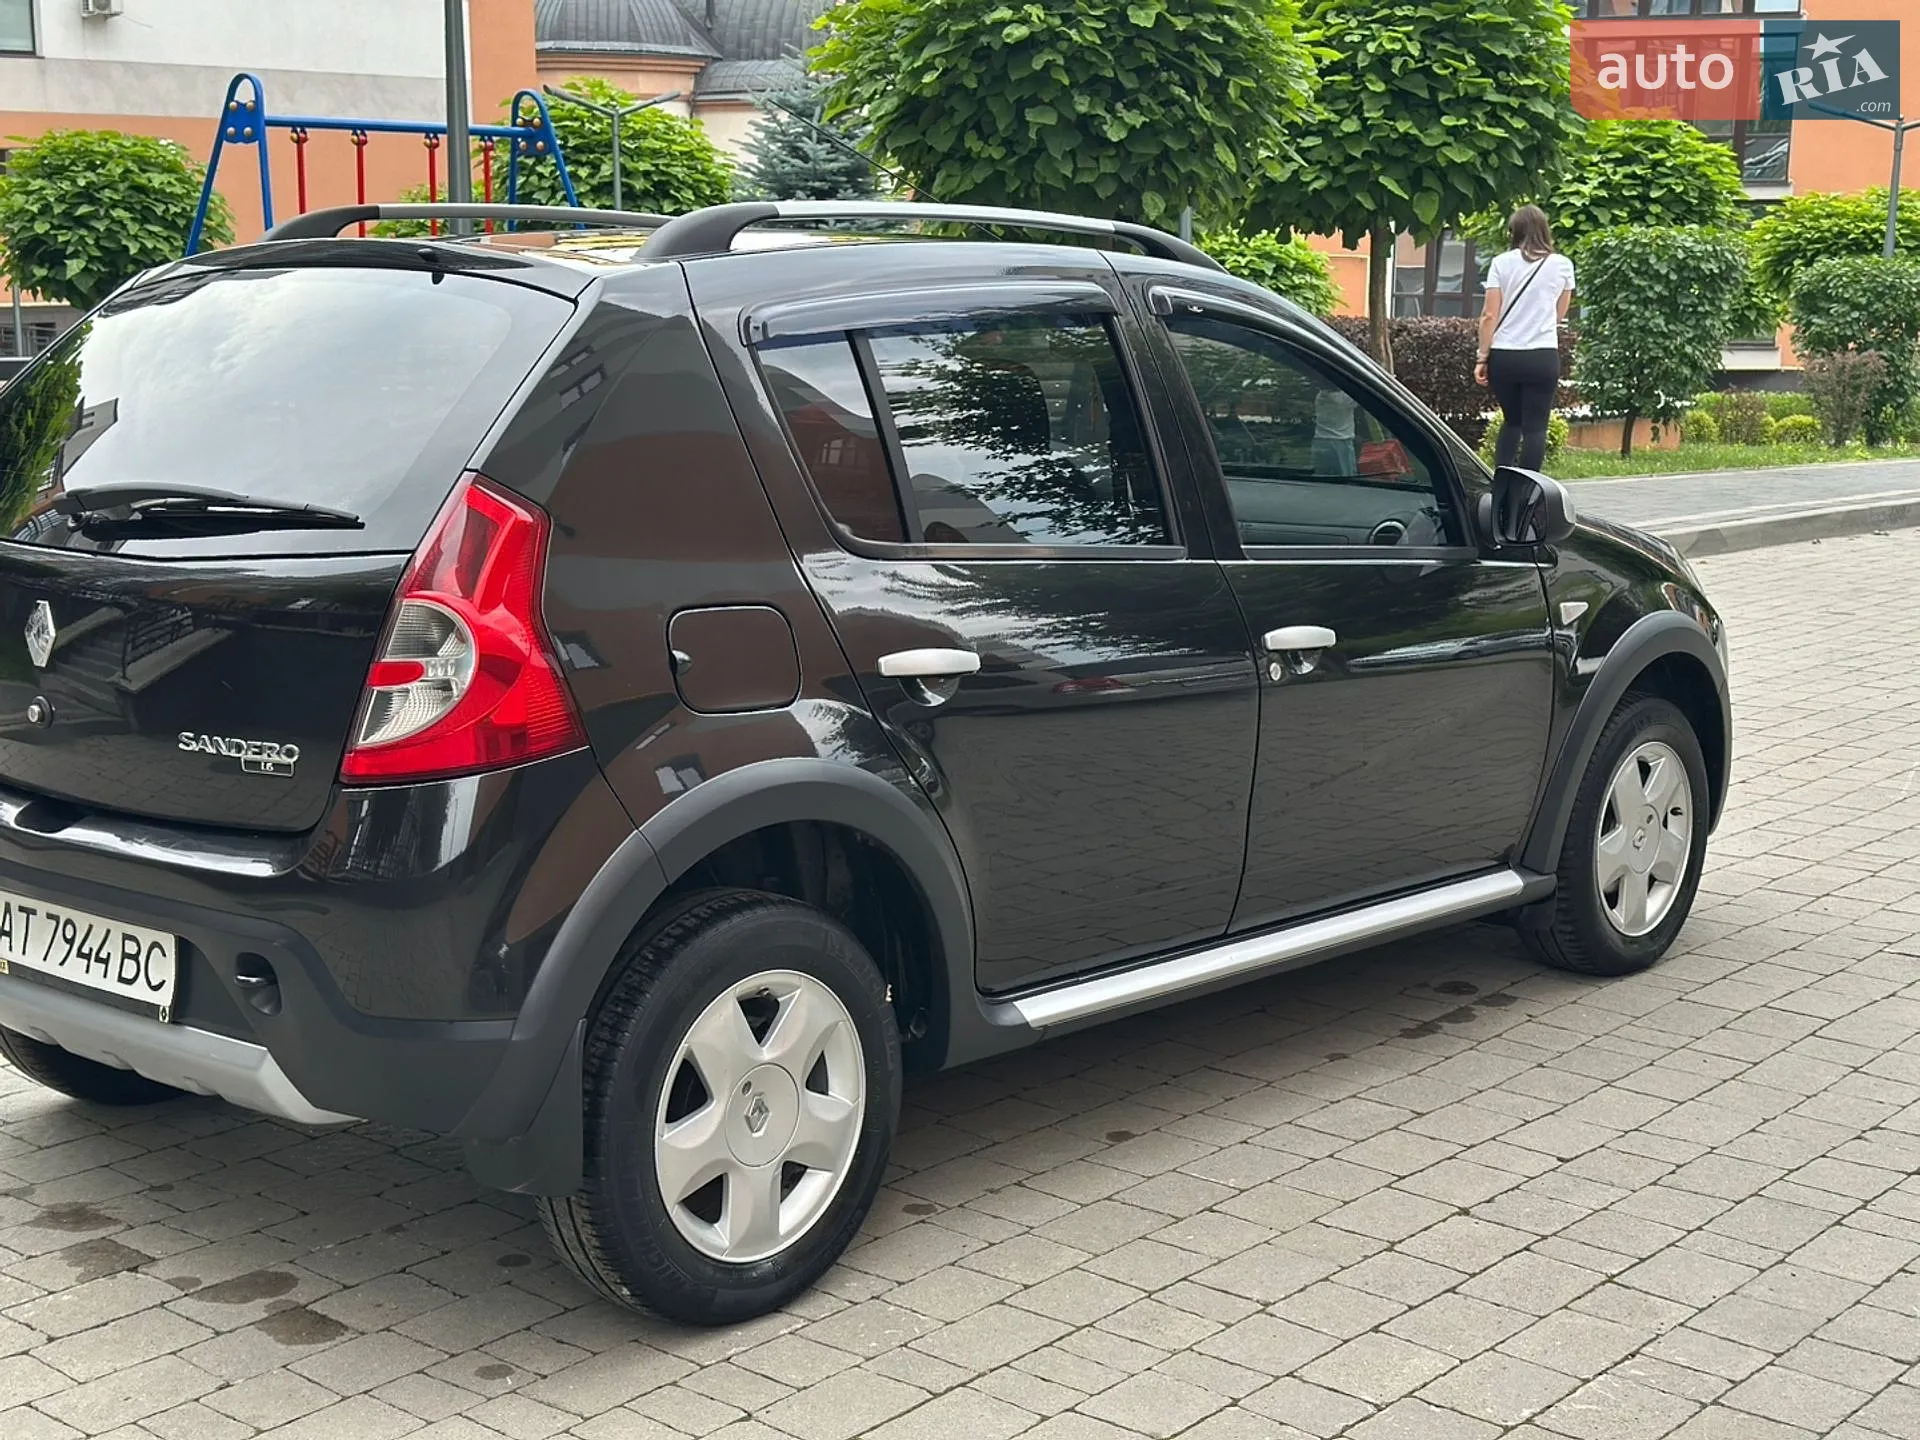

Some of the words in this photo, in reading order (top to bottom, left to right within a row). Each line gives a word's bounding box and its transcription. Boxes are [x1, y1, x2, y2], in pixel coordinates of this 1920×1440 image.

[178, 731, 300, 762] SANDERO
[43, 912, 111, 978] 7944
[117, 932, 167, 992] BC
